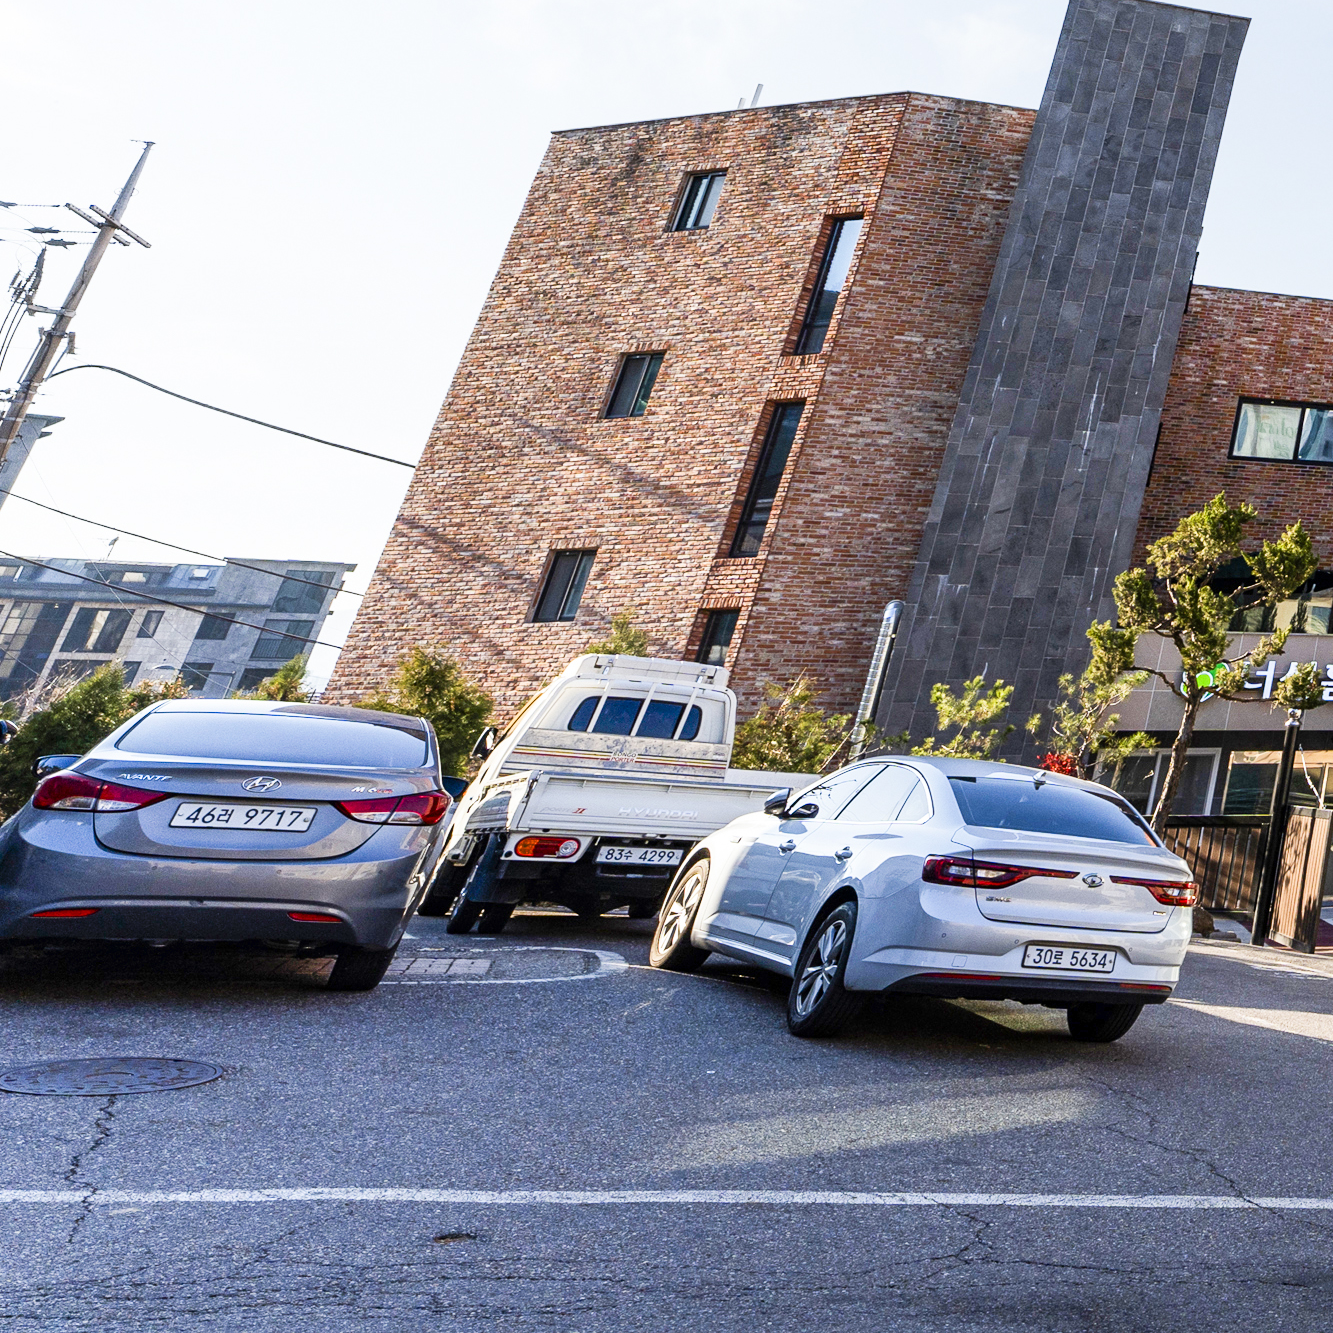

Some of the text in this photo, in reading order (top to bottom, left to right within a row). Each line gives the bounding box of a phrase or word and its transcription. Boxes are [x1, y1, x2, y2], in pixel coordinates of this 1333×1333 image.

[186, 806, 303, 827] 46러 9717
[618, 807, 699, 819] HYUNDAI
[604, 848, 675, 863] 83수 4299
[1069, 951, 1107, 969] 5634
